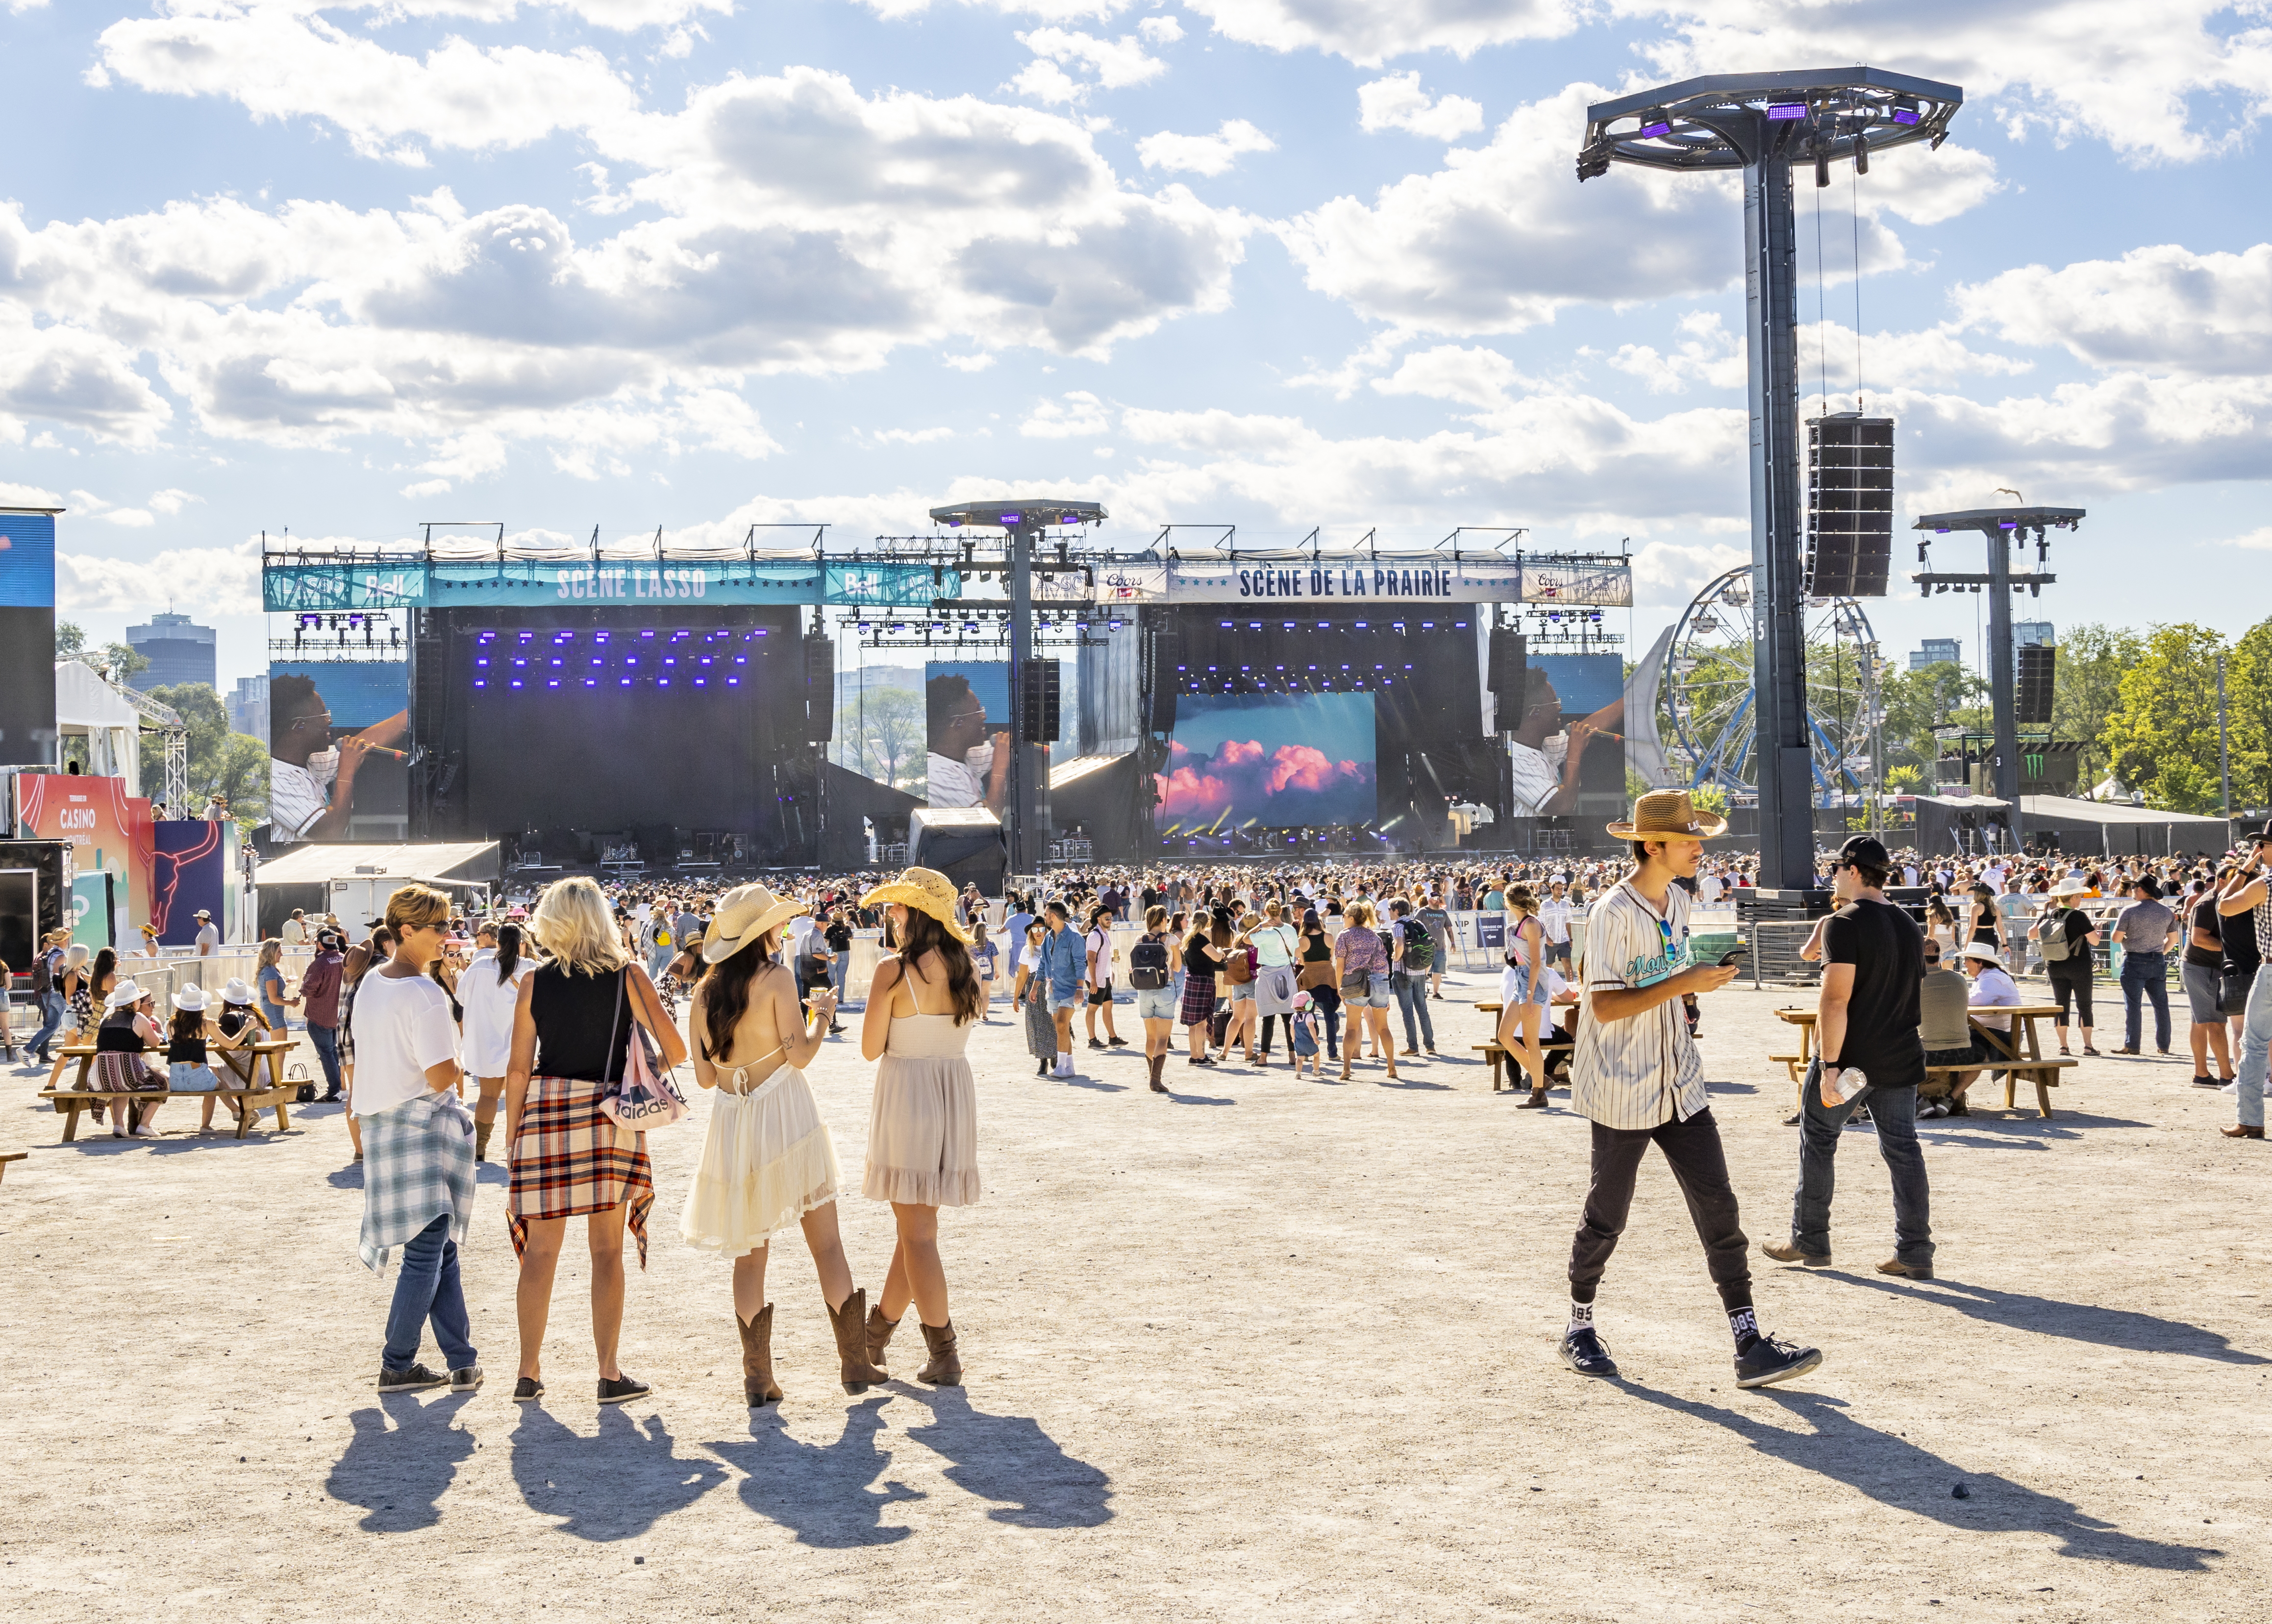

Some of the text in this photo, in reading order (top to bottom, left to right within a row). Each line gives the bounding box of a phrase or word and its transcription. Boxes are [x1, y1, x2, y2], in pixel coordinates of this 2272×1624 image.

[282, 576, 344, 594] LASSO
[366, 575, 404, 598] Bell
[557, 563, 706, 599] SCÈNE LASSO
[845, 573, 877, 595] Bell
[1031, 575, 1085, 592] ASSO
[1106, 573, 1143, 586] Coors
[1240, 563, 1451, 597] SCÈNE DE LA PRAIRIE
[1538, 573, 1564, 587] Coors
[1578, 576, 1618, 592] LASSO
[1758, 620, 1765, 641] 5
[1996, 756, 2001, 767] 3
[60, 808, 96, 829] CASINO
[1572, 1303, 1593, 1322] 985
[1730, 1310, 1758, 1335] 985
